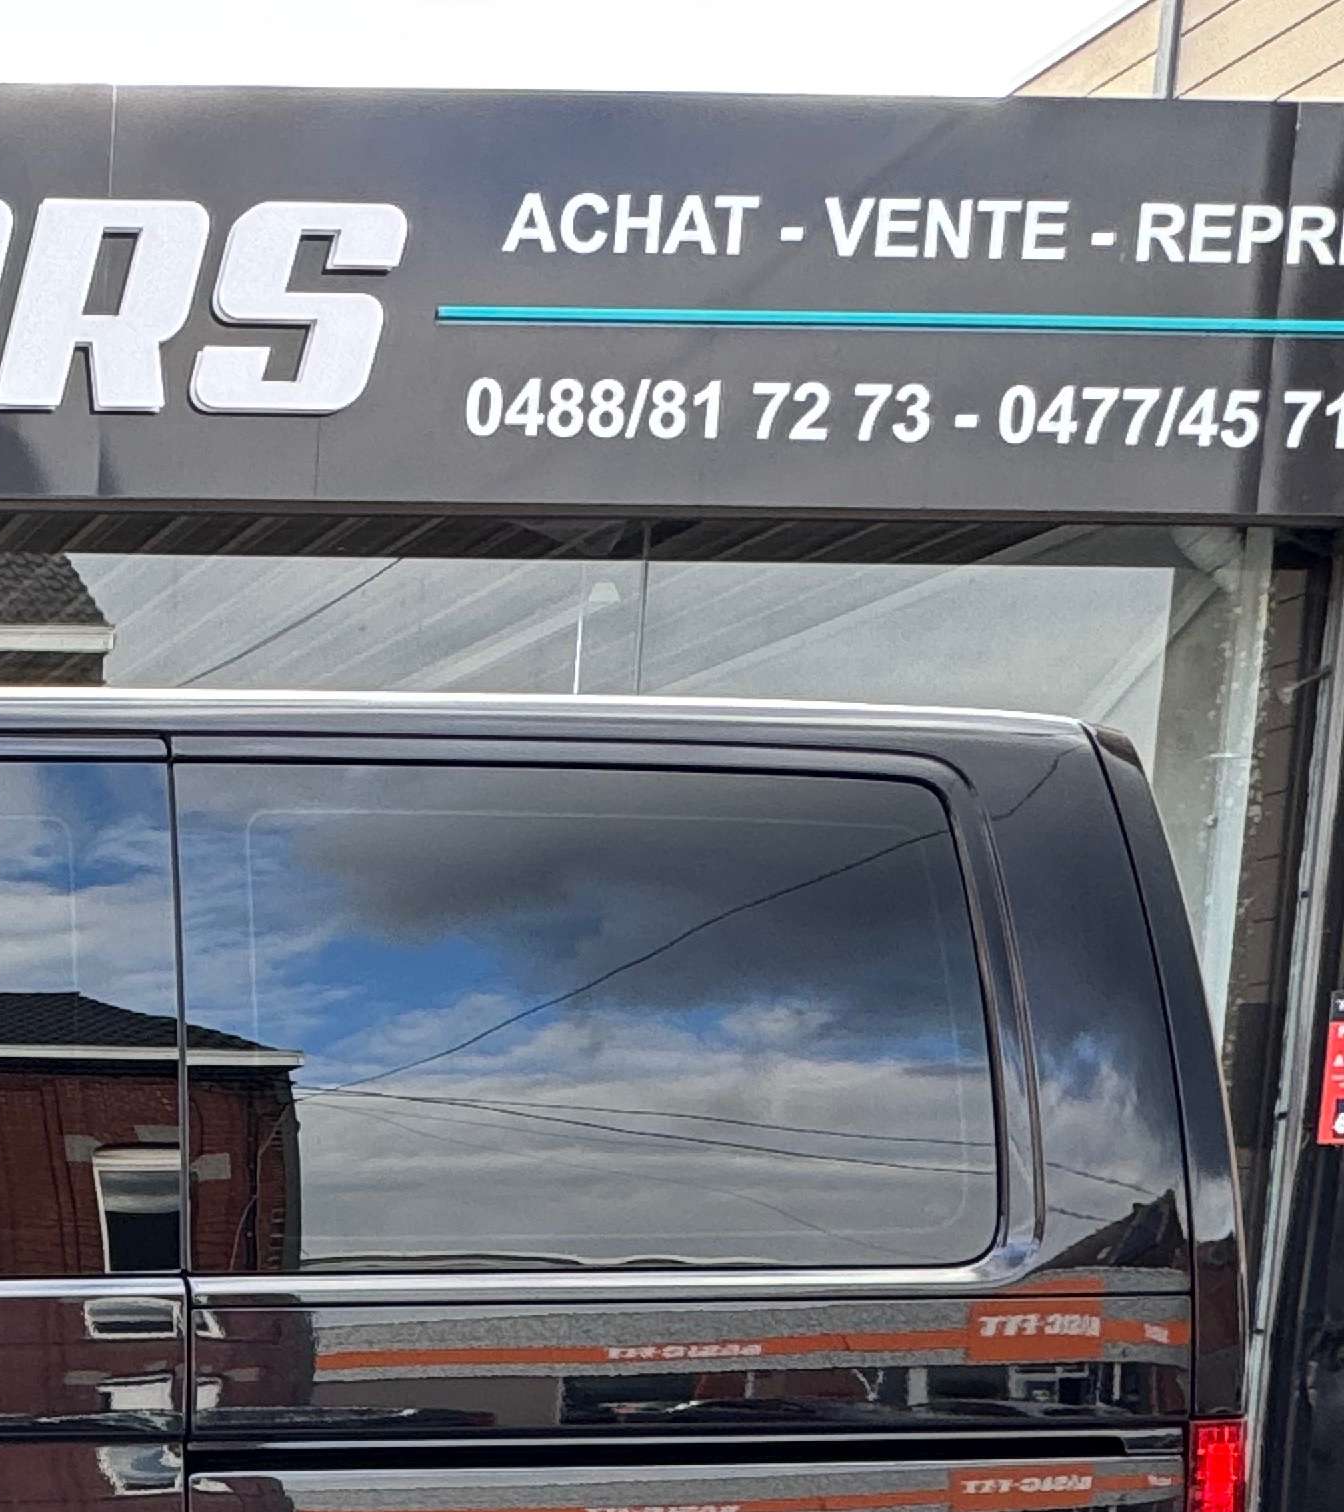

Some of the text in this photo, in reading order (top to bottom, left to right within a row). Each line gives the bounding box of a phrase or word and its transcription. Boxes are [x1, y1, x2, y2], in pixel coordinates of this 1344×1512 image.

[501, 192, 761, 256] ACHAT
[780, 226, 804, 242] -
[824, 196, 1070, 260] VENTE
[1090, 231, 1115, 246] -
[466, 376, 722, 439] 0488/81
[752, 381, 830, 441] 72
[854, 383, 930, 443] 73
[954, 414, 980, 428] -
[998, 384, 1261, 448] 0477/45
